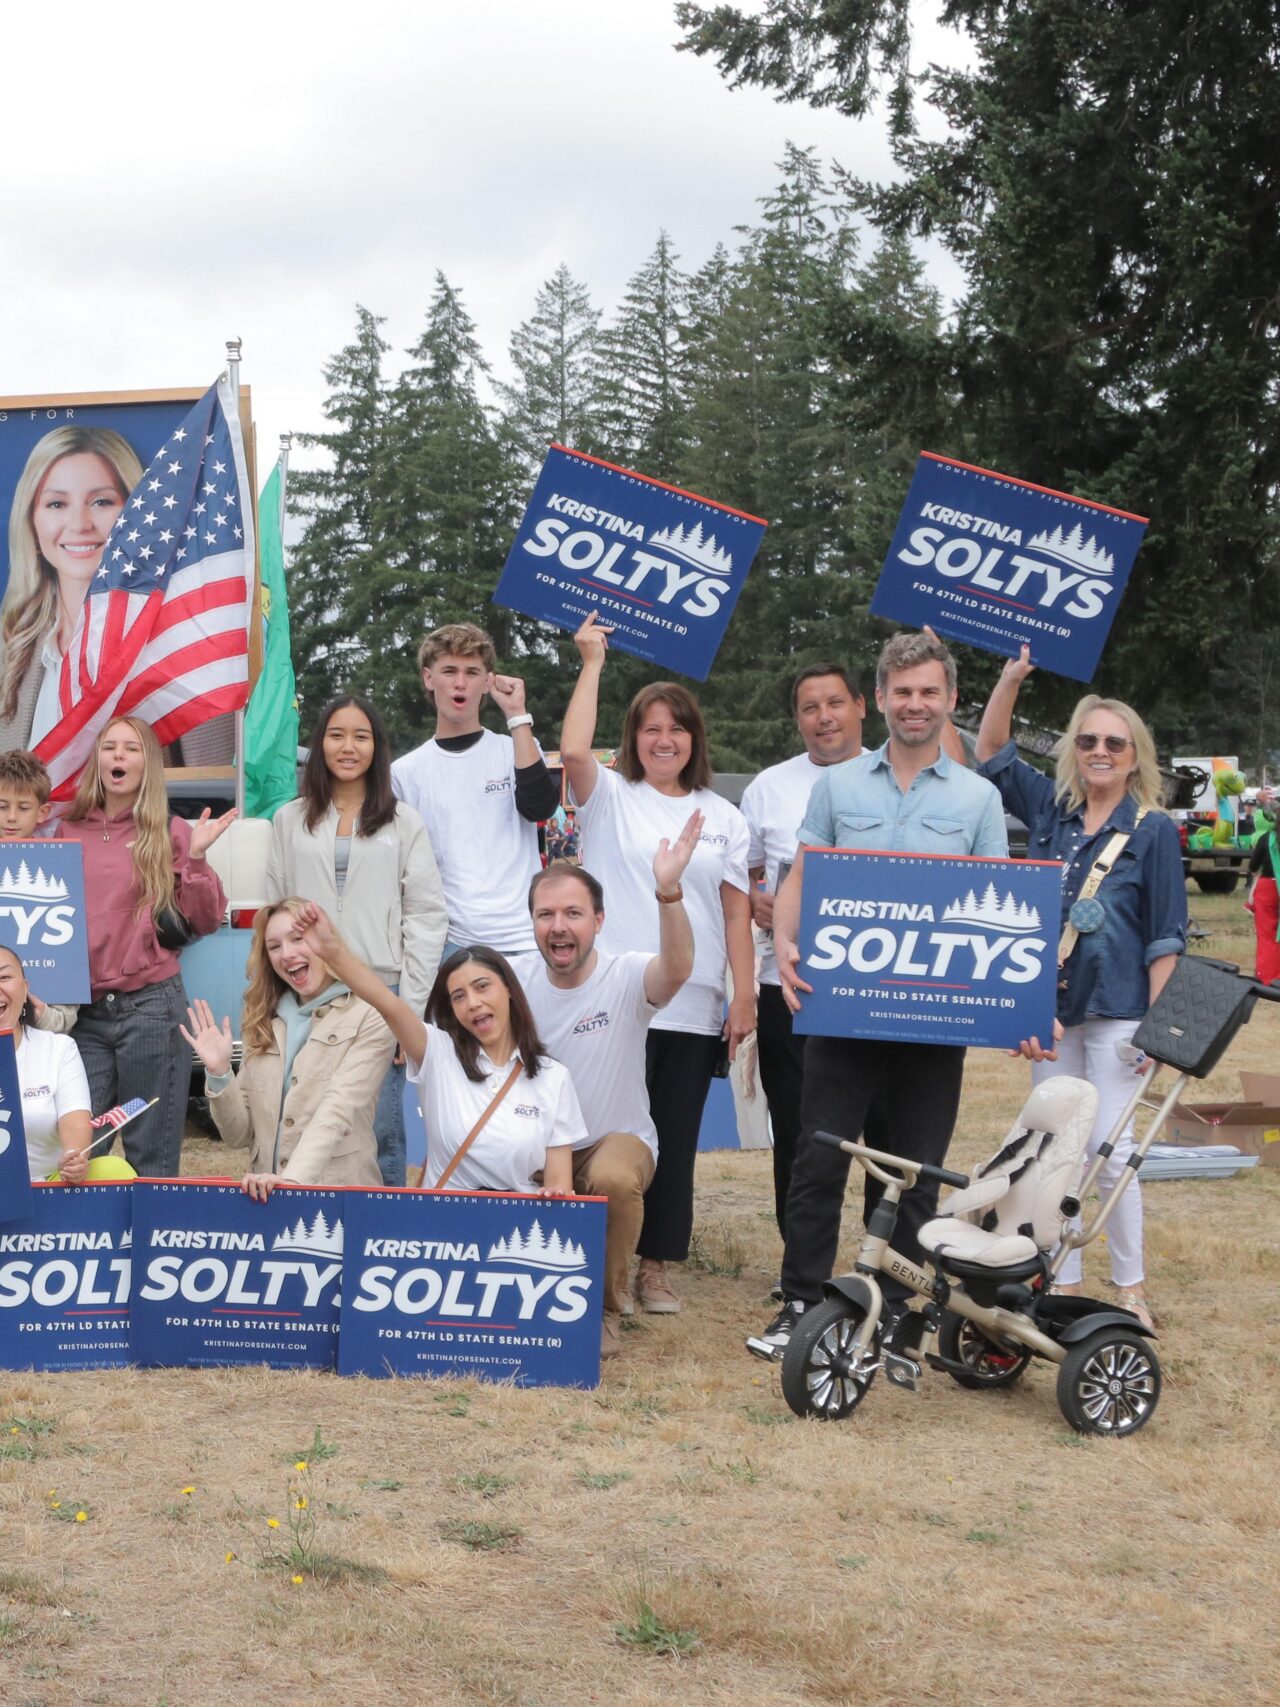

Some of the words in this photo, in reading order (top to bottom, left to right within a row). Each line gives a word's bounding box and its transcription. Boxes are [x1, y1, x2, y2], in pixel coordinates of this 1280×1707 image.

[30, 408, 74, 420] FOR
[546, 493, 644, 542] KRISTINA
[920, 502, 1022, 546] KRISTINA
[522, 518, 730, 617] SOLTYS
[897, 527, 1113, 618] SOLTYS
[536, 573, 556, 585] FOR
[559, 582, 584, 596] 47TH
[586, 592, 598, 601] LD
[601, 597, 632, 614] STATE
[634, 610, 673, 629] SENATE
[674, 624, 687, 635] (R)
[913, 582, 933, 594] FOR
[936, 590, 963, 603] 47TH
[965, 598, 978, 608] LD
[981, 603, 1013, 619] STATE
[1016, 614, 1055, 632] SENATE
[1057, 627, 1071, 638] (R)
[562, 603, 648, 639] KRISTINORSENATE.COM
[941, 611, 1031, 643] KRISTINAFORSENATE.COM
[485, 782, 512, 793] SOLTY
[943, 861, 1006, 870] FIGHTING
[819, 898, 934, 922] KRISTINA
[43, 959, 55, 968] (R)
[807, 925, 1047, 983] SOLTYS
[832, 987, 855, 996] FOR
[860, 989, 889, 999] 47TH
[893, 991, 907, 1000] LD
[912, 993, 948, 1003] STATE
[952, 995, 997, 1006] SENATE
[1000, 998, 1015, 1008] (R)
[573, 1017, 609, 1034] SOLTYS
[870, 1011, 974, 1024] KRISTINAFORSENATE.COM
[272, 1190, 335, 1198] FIGHTING
[488, 1198, 551, 1207] FIGHTING
[0, 1232, 113, 1252] KRISTINA
[151, 1229, 265, 1251] KRISTINA
[364, 1239, 480, 1262] KRISTINA
[140, 1256, 343, 1307] SOLTY
[352, 1266, 592, 1322] SOLTYS
[19, 1323, 41, 1331] FOR
[46, 1322, 74, 1331] 47TH
[79, 1322, 92, 1330] LD
[166, 1317, 188, 1326] FOR
[193, 1319, 222, 1327] 47TH
[226, 1320, 240, 1328] LD
[244, 1321, 280, 1330] STATE
[285, 1323, 328, 1332] SENATE
[58, 1342, 129, 1350] KRISTINAFORSENA
[204, 1340, 307, 1350] KRISTINAFORSENATE.COM
[379, 1329, 401, 1338] FOR
[406, 1331, 435, 1340] 47TH
[440, 1333, 453, 1341] LD
[458, 1334, 494, 1344] STATE
[499, 1336, 544, 1346] SENATE
[547, 1337, 562, 1348] (R)
[417, 1353, 521, 1364] KRISTINAFORSENATE.COM
